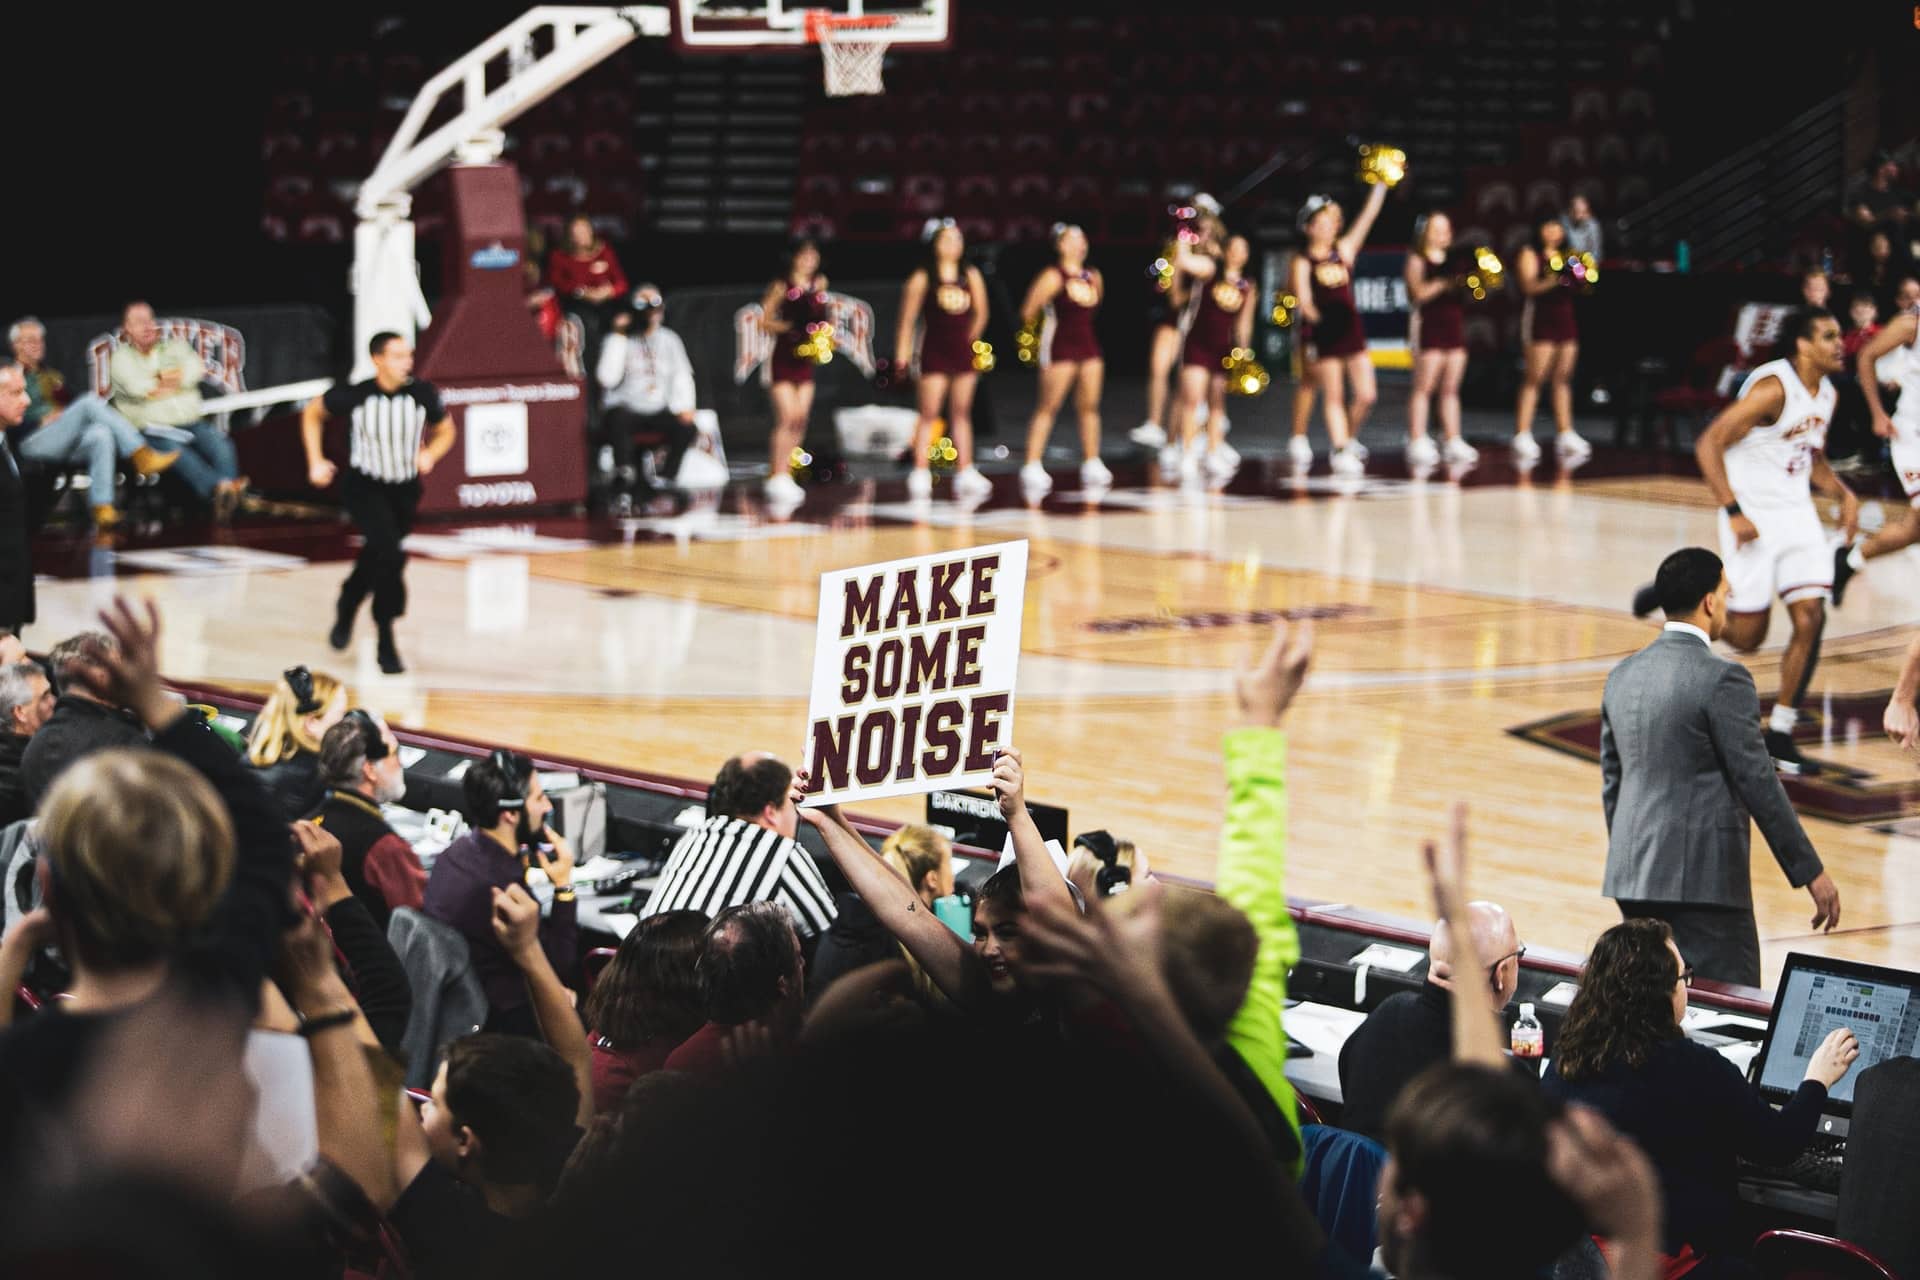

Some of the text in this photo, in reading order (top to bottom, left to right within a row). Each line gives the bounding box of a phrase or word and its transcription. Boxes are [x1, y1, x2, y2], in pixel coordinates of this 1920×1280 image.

[458, 481, 537, 507] TOYOTA
[839, 552, 1001, 640] MAKE
[840, 622, 987, 707] SOME
[805, 690, 1010, 796] NOISE
[932, 791, 1006, 821] DAKTRON
